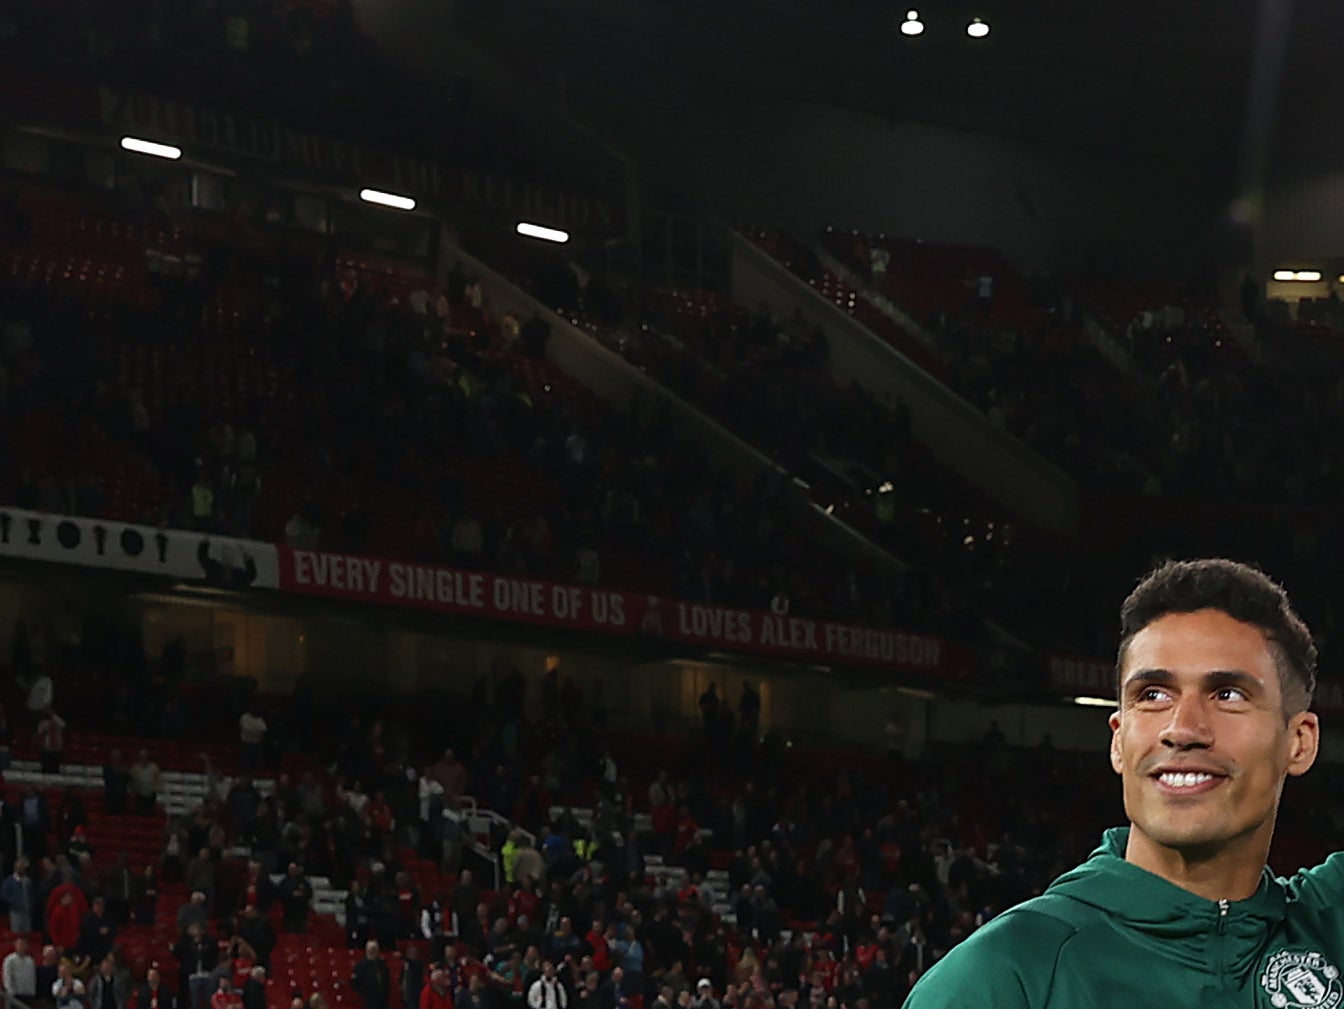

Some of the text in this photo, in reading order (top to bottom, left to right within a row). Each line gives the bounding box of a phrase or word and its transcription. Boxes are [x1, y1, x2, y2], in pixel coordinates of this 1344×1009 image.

[293, 549, 626, 627] EVERY SINGLE ONE OF US
[678, 602, 941, 667] LOVES ALEX FERGUSON
